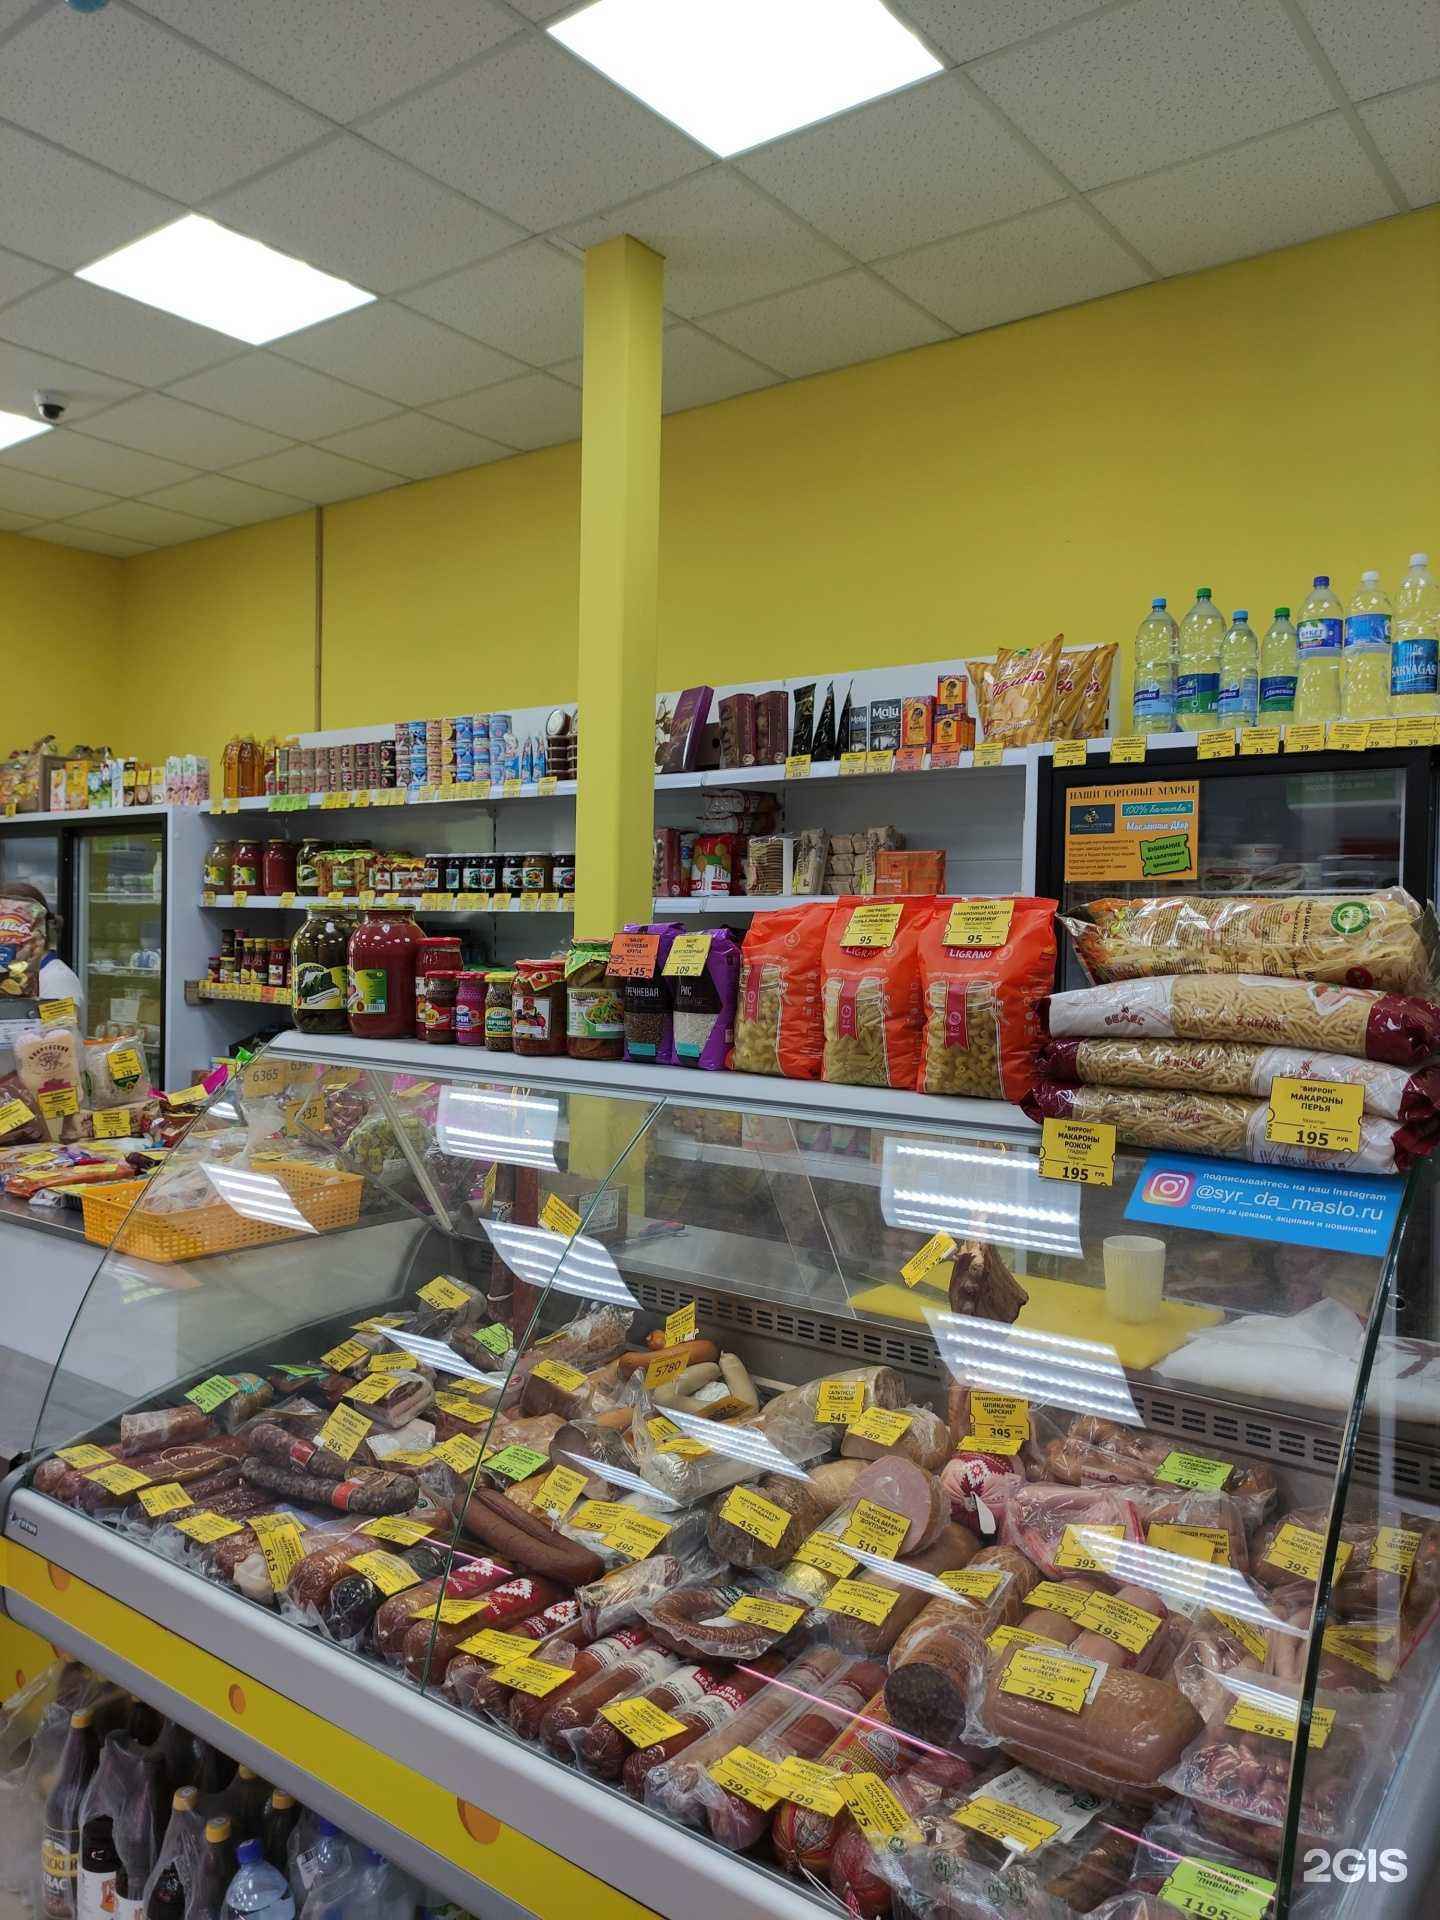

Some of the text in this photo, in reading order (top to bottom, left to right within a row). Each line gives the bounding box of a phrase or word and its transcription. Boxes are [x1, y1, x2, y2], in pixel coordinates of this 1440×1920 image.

[1070, 785, 1195, 800] НАШИ ТОРГОВЫЕ МАРКИ
[858, 936, 872, 945] 95
[966, 935, 983, 944] 95
[949, 949, 992, 959] LIGRANO
[629, 966, 646, 976] 145
[253, 1069, 279, 1082] 6365
[1290, 1093, 1344, 1105] МАКАРОНЫ
[1301, 1103, 1331, 1112] ПЕРЬЯ
[1057, 1132, 1100, 1143] МАКАРОНЫ
[1295, 1130, 1329, 1146] 195
[1064, 1140, 1092, 1150] РОЖОК
[1062, 1166, 1089, 1180] 195
[1202, 1173, 1290, 1190] подписывайтесь
[1308, 1185, 1330, 1194] наш
[1333, 1187, 1387, 1202] Instagram
[1196, 1184, 1384, 1221] @syr_da_maslo.ru
[1191, 1204, 1225, 1215] следите
[1325, 1222, 1377, 1235] новинками
[655, 1360, 682, 1377] 5780
[829, 1413, 847, 1423] 545
[990, 1428, 1011, 1438] 395
[327, 1439, 343, 1452] 945
[1174, 1477, 1198, 1487] 449
[739, 1520, 761, 1535] 455
[857, 1539, 878, 1555] 519
[1074, 1558, 1096, 1568] 395
[1284, 1560, 1310, 1575] 395
[839, 1604, 863, 1616] 435
[1094, 1623, 1121, 1640] 195
[1026, 1686, 1056, 1702] 225
[613, 1718, 638, 1735] 515
[1253, 1724, 1287, 1737] 945
[723, 1778, 752, 1797] 595
[786, 1790, 814, 1806] 199
[848, 1798, 873, 1828] 375
[1182, 1896, 1231, 1920] 1195
